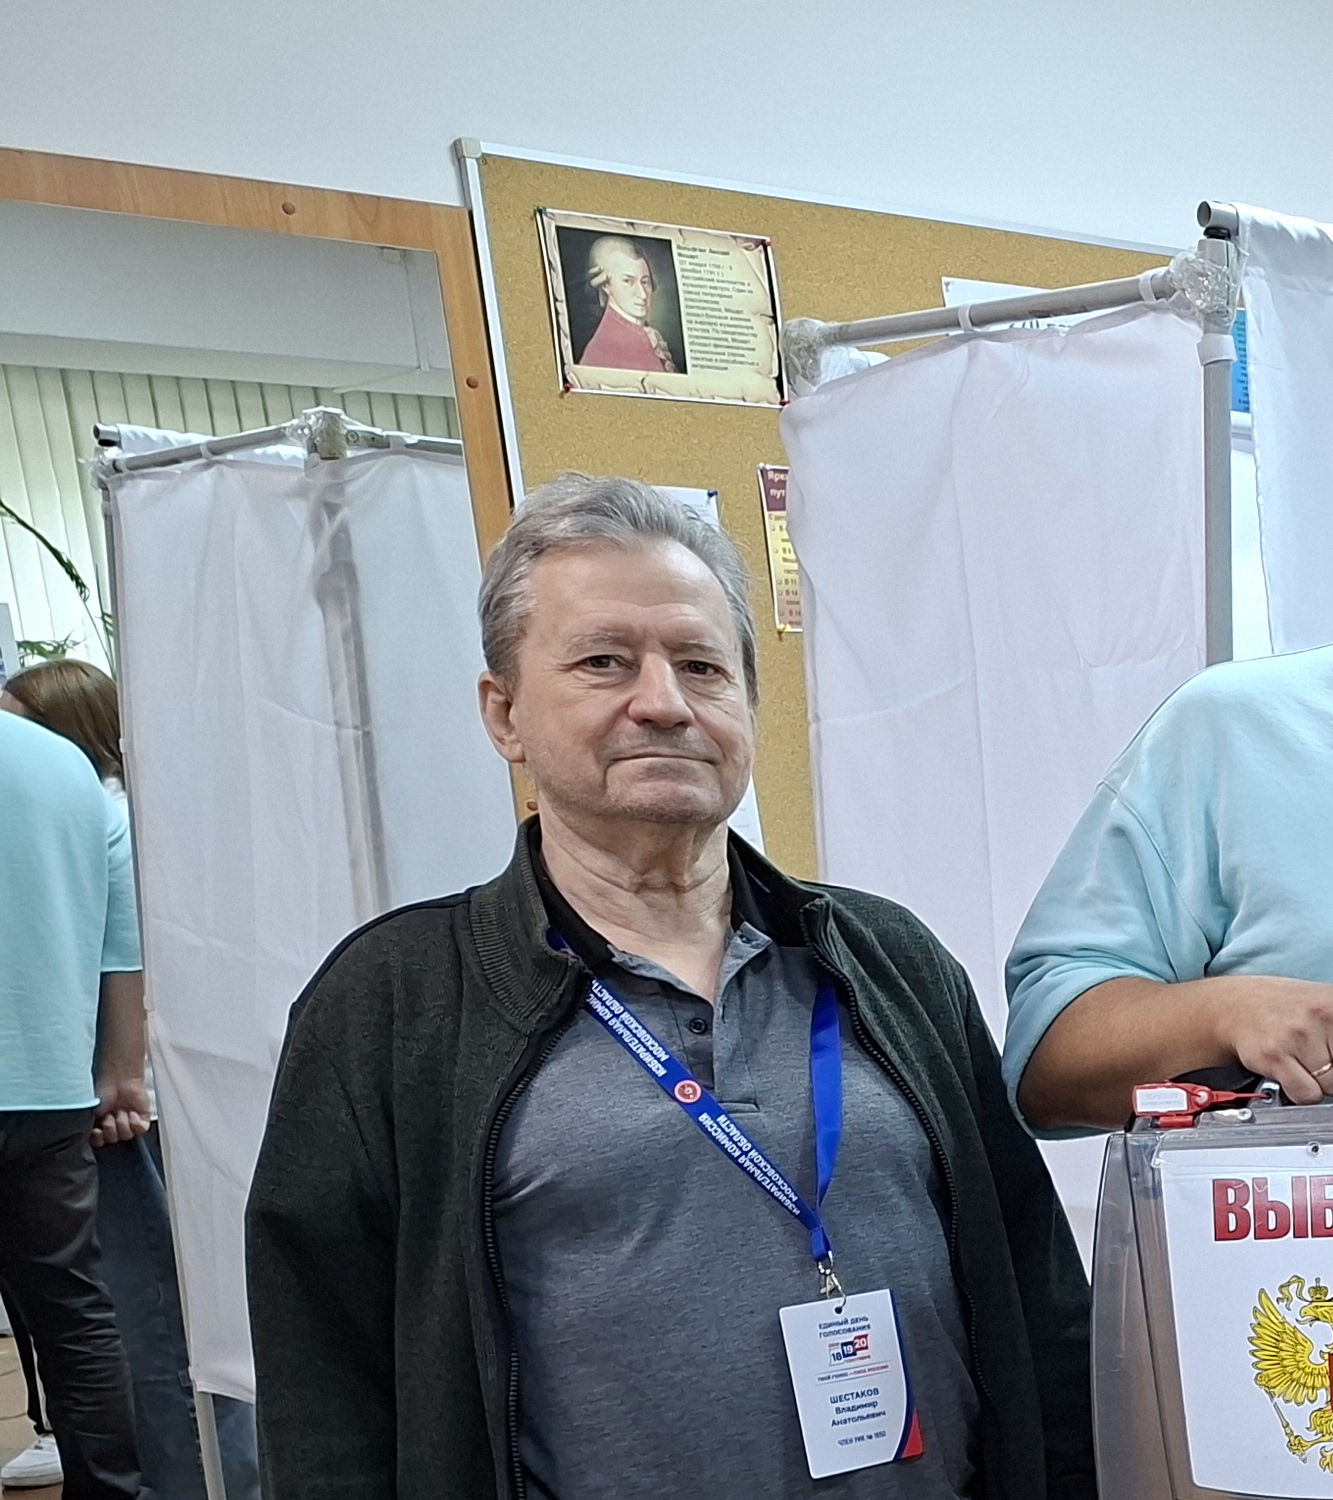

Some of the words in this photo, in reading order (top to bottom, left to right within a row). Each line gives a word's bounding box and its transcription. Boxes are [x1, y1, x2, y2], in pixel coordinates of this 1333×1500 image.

[584, 992, 613, 1021] КОМИС
[608, 1017, 667, 1077] ИЗБИРАТЕЛЬНАЯ
[618, 1011, 669, 1062] МОСКОВСКОЙ
[697, 1111, 742, 1158] КОМИССИЯ
[715, 1113, 752, 1151] ОБЛАСТИ
[737, 1154, 800, 1215] ИЗБИРАТЕЛЬНАЯ
[746, 1148, 798, 1202] МОСКОВСКОЙ
[819, 1324, 871, 1338] ГОЛОСОВАНИЯ
[831, 1352, 843, 1362] 18
[842, 1344, 854, 1355] 19
[854, 1338, 867, 1348] 20
[830, 1388, 880, 1404] ШЕСТАКОВ
[835, 1401, 879, 1415] Владимир
[831, 1410, 886, 1427] Анатольевич
